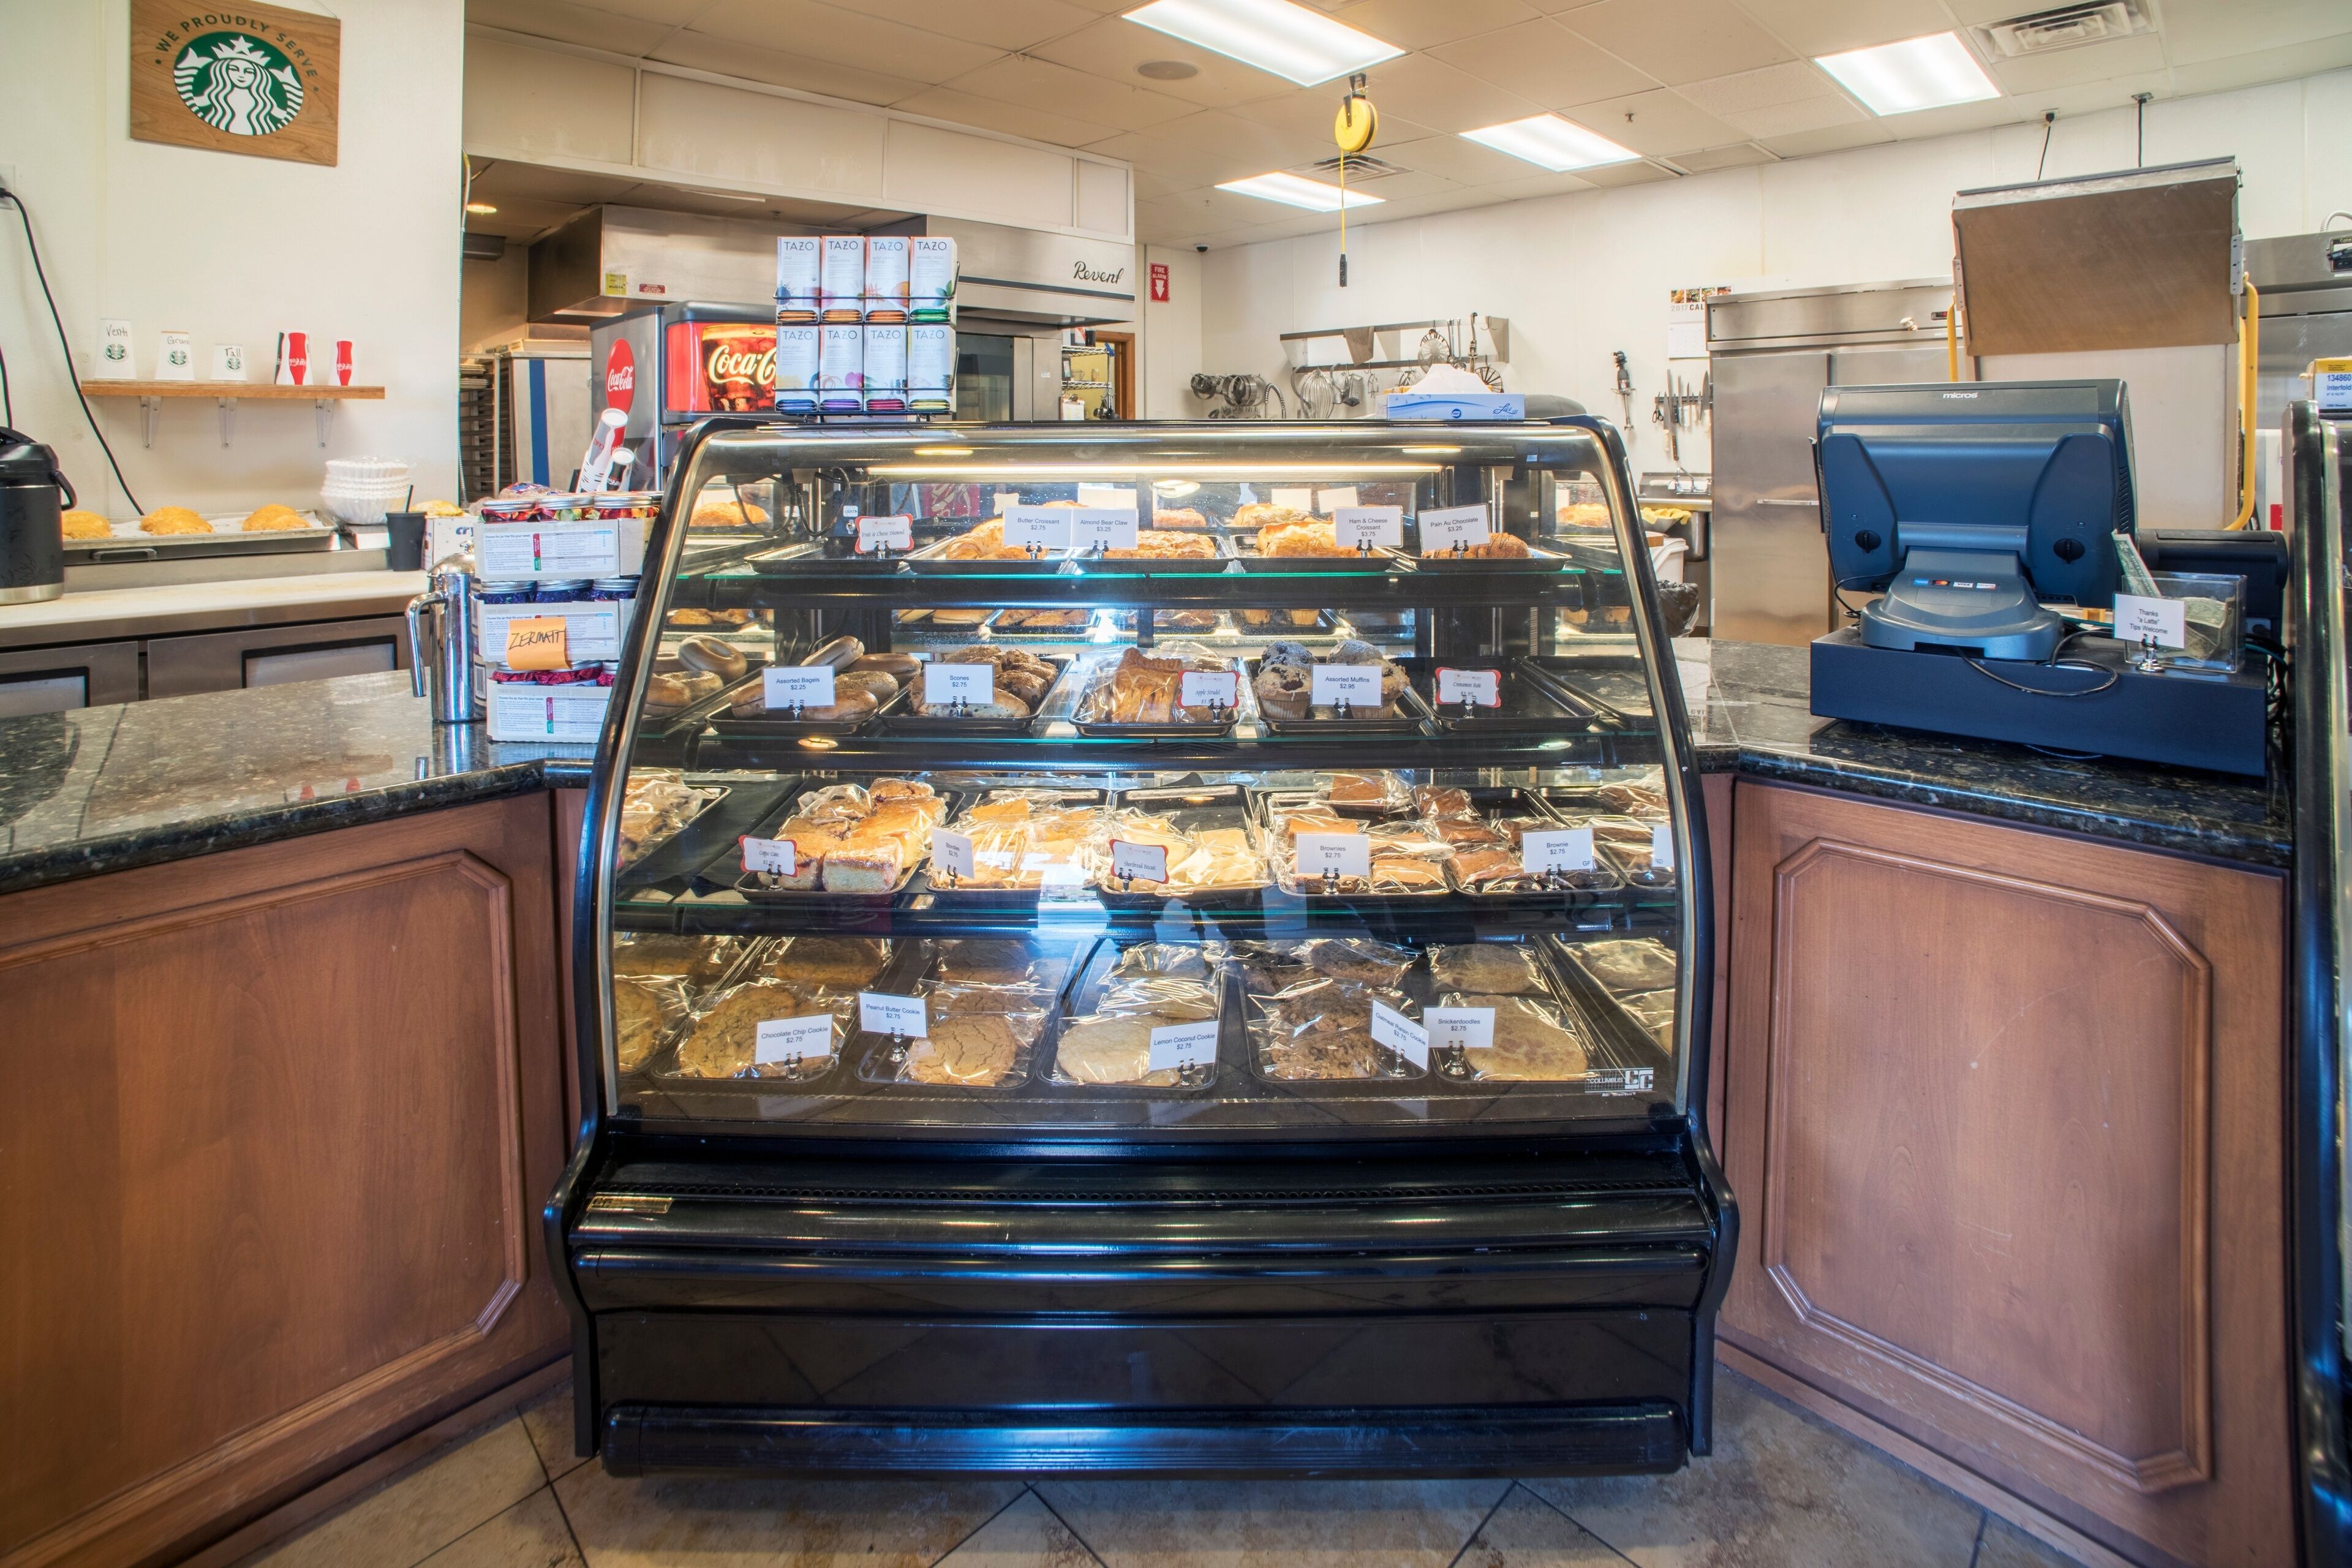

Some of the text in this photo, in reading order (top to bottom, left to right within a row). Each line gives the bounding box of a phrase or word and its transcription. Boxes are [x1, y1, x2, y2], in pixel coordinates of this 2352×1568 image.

[156, 13, 318, 77] WE PROUDLY SERVE
[784, 241, 814, 251] TAZO
[828, 241, 858, 250] TAZO
[873, 241, 903, 251] TAZO
[917, 241, 947, 251] TAZO
[1073, 261, 1124, 284] Revent
[105, 324, 128, 337] Venti
[783, 331, 813, 340] TAZO
[827, 330, 858, 339] TAZO
[871, 330, 902, 339] TAZO
[914, 330, 945, 339] TAZO
[224, 348, 241, 358] Tall
[709, 344, 776, 385] Coca-C
[608, 365, 634, 392] Coca-Cola
[2143, 625, 2168, 635] Welcome
[509, 629, 566, 650] ZERMATT
[946, 842, 960, 851] Blondies
[1376, 1012, 1426, 1046] Oatmeal Raisin Cookie
[1393, 1030, 1406, 1041] $2.75
